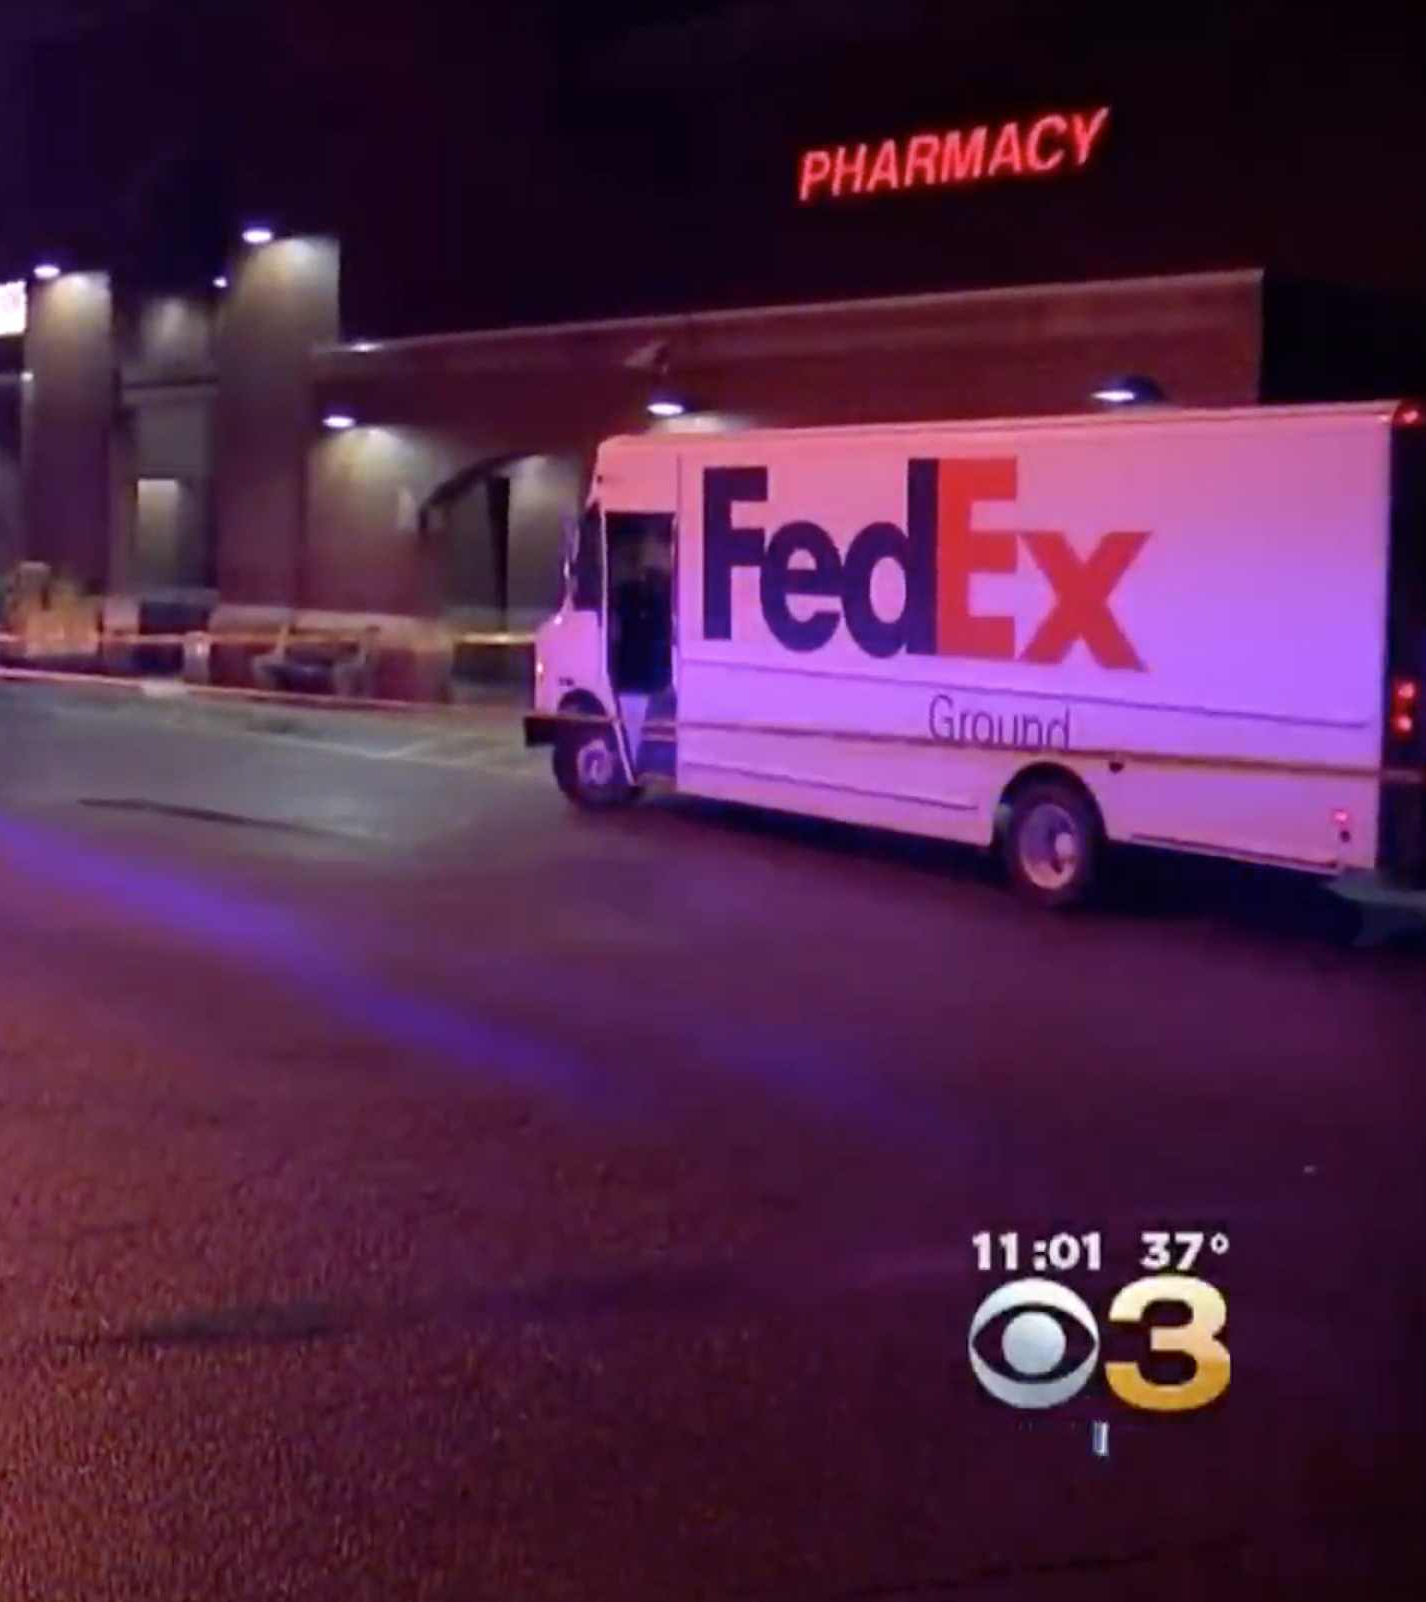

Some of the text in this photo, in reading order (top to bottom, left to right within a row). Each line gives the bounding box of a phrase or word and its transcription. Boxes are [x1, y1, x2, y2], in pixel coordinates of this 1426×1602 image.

[798, 106, 1111, 202] PHARMACY
[702, 457, 1152, 673] FedEx
[927, 693, 1071, 750] Ground
